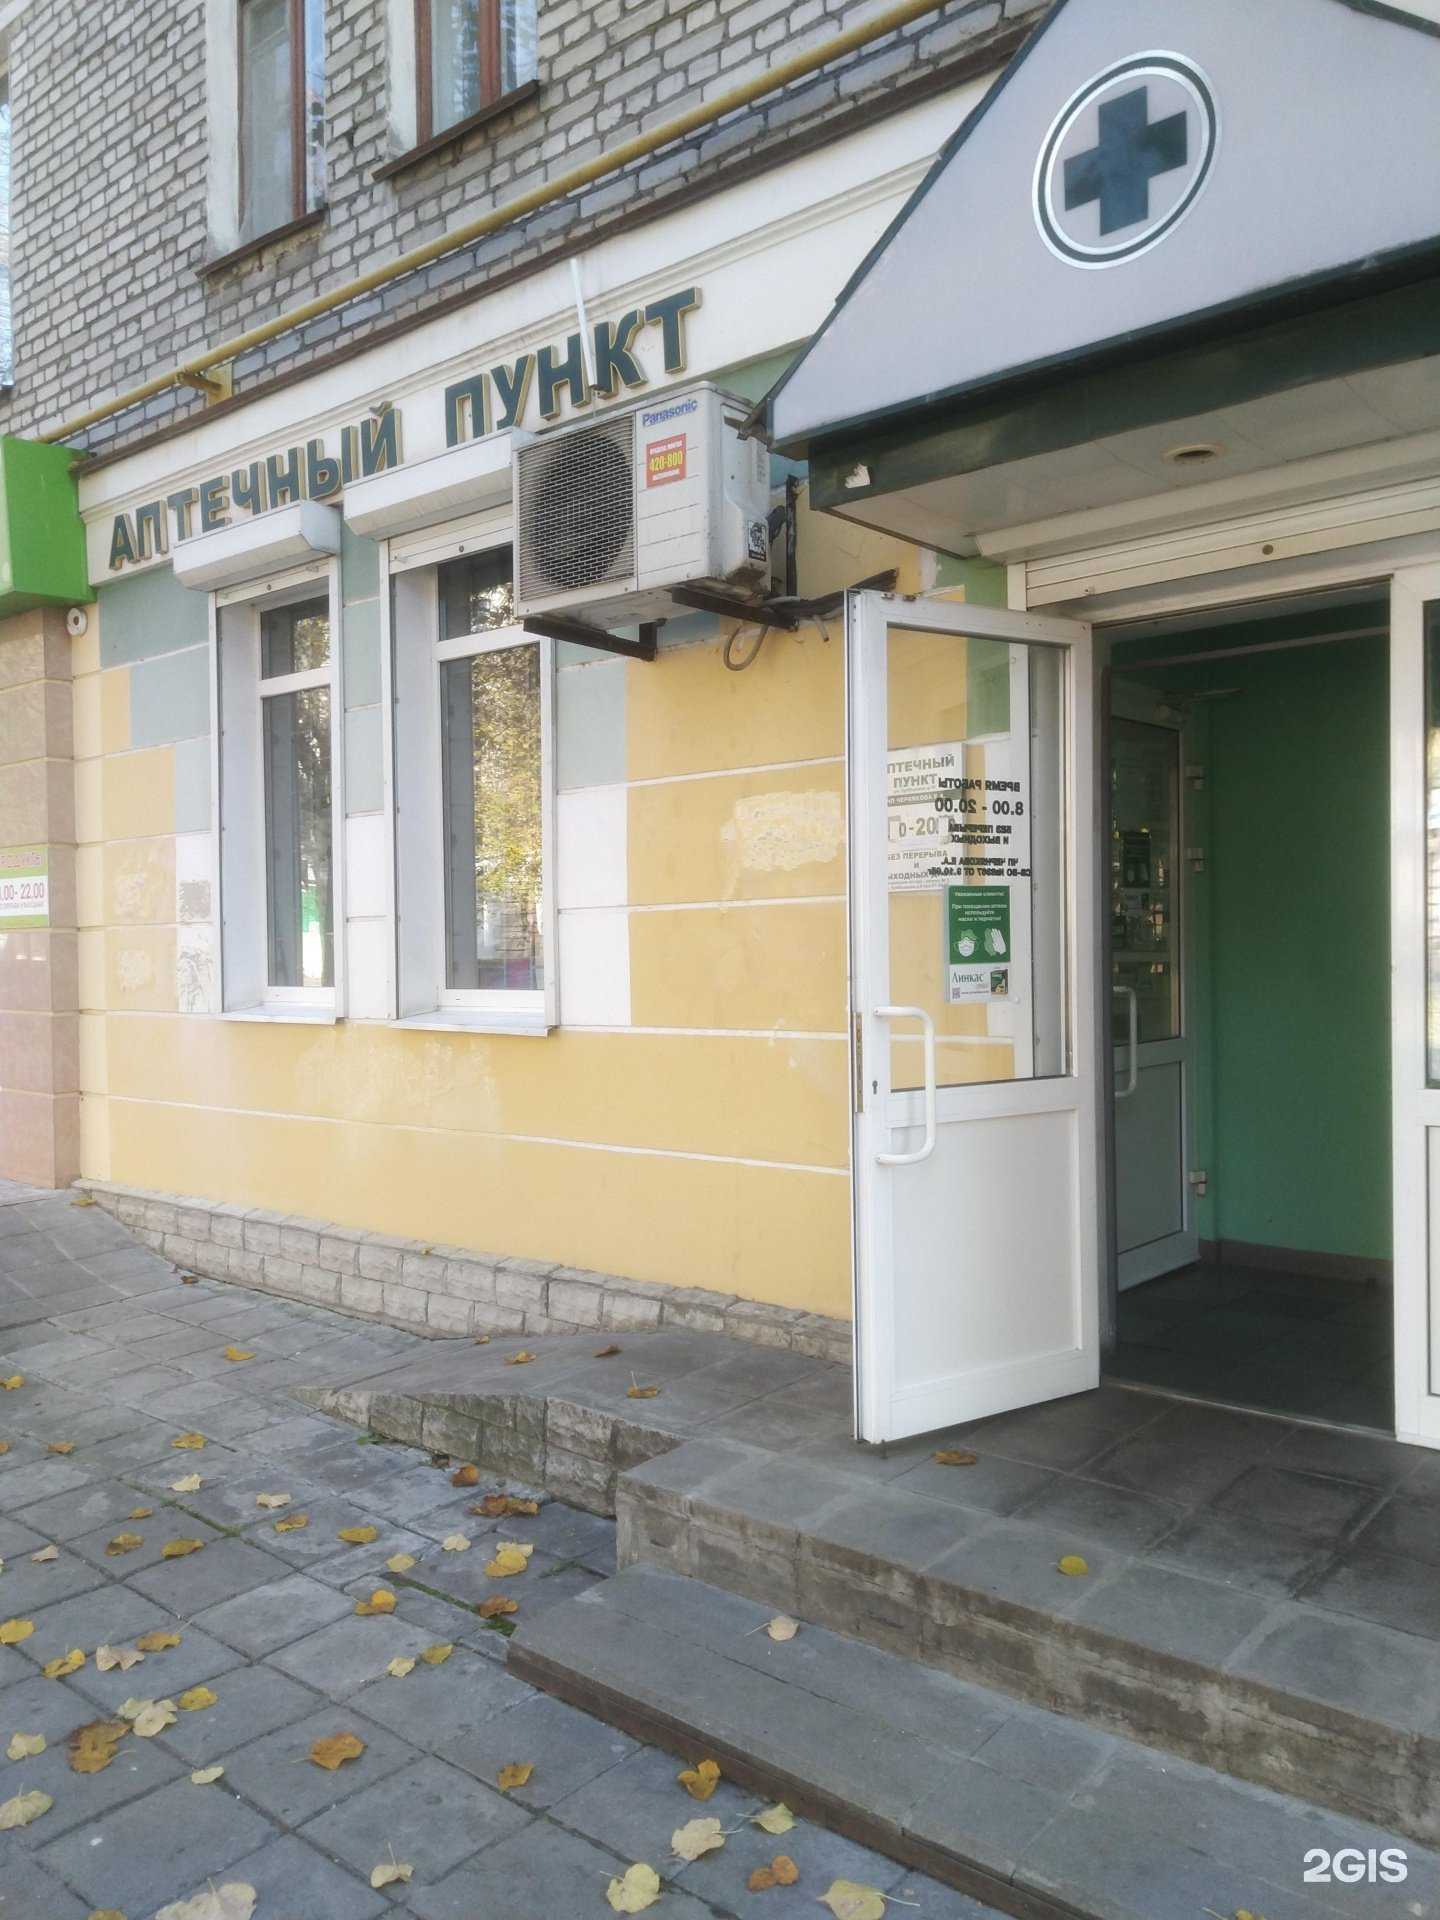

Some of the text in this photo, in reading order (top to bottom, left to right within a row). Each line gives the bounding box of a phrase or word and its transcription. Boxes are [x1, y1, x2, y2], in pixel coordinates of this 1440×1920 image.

[642, 399, 699, 427] Panasonic
[107, 286, 702, 570] АПТЕЧНЫЙ ПУНКТ
[650, 450, 683, 472] 420-800
[887, 753, 955, 774] ПТЕЧНЫЙ
[894, 773, 938, 789] ПУНКТ
[887, 871, 929, 880] ЫХОДНЫХ
